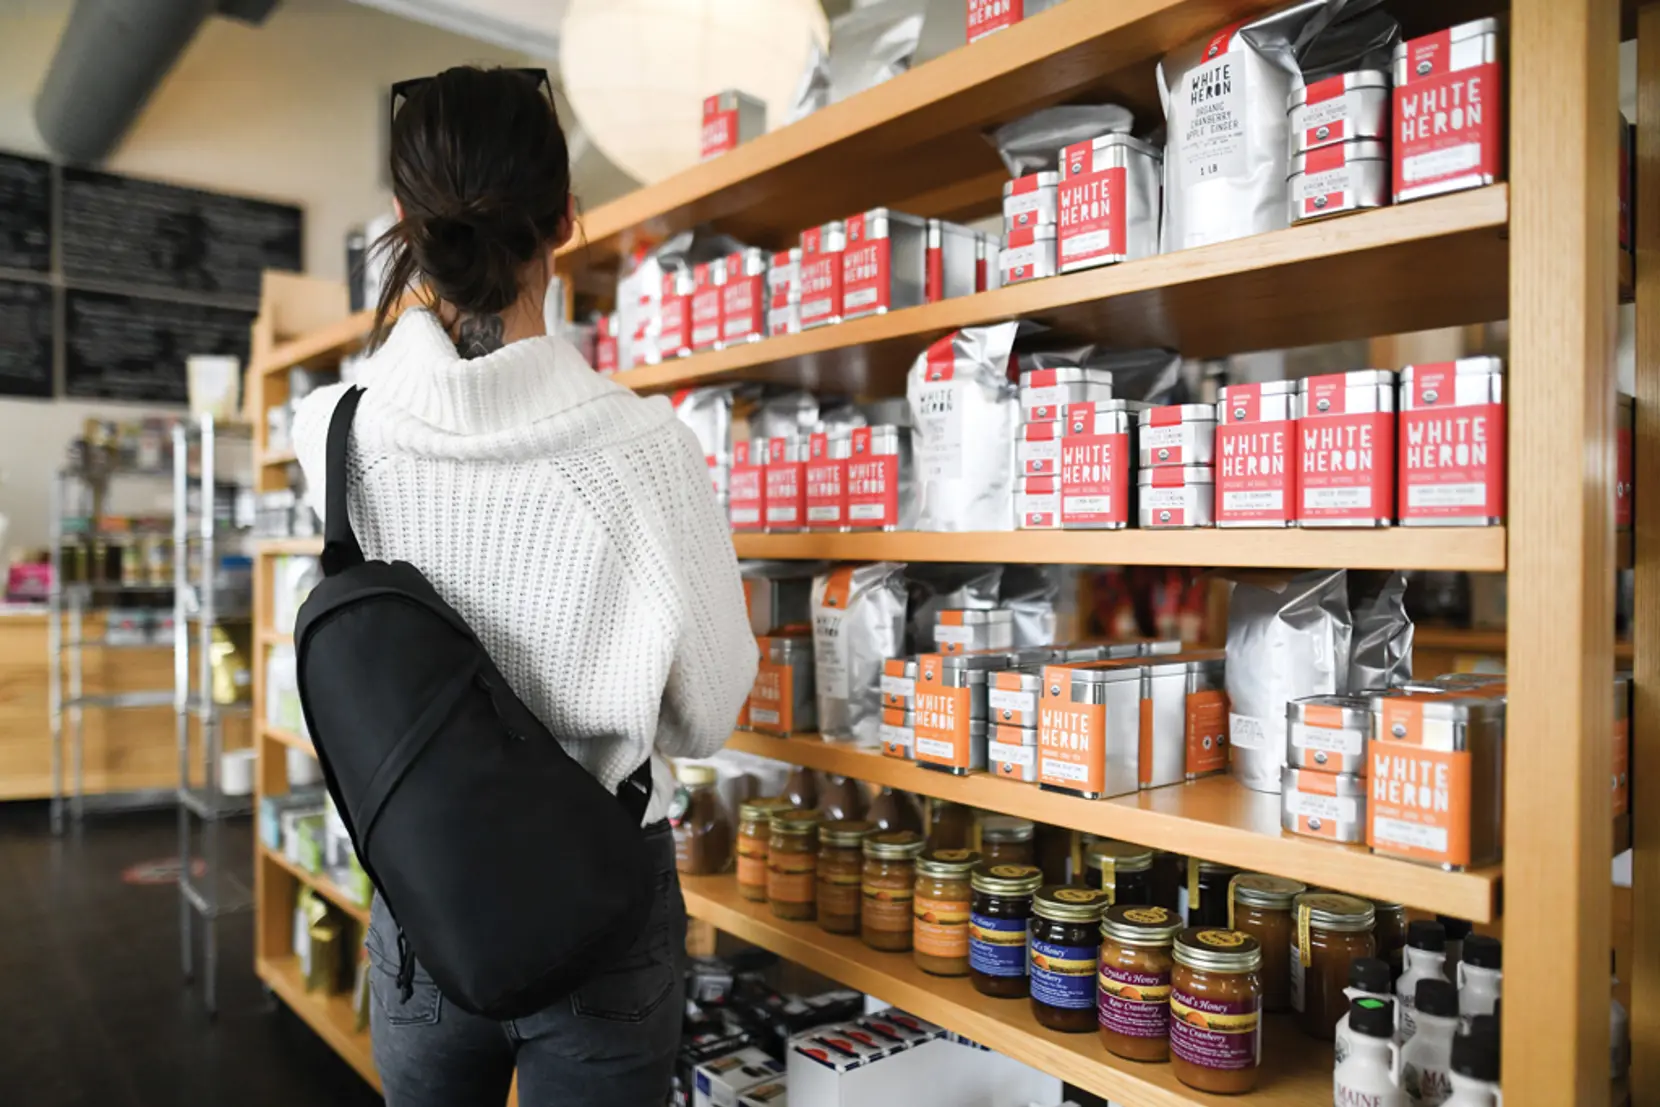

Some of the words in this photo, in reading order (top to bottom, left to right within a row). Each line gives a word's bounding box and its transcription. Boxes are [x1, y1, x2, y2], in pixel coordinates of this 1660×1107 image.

[1192, 64, 1231, 91] WHITE
[1190, 81, 1232, 106] HERON
[1402, 77, 1482, 118] WHITE
[1401, 103, 1482, 142] HERON
[1061, 179, 1110, 209] WHITE
[1061, 200, 1111, 227] HERON
[1304, 424, 1373, 449] WHITE
[1407, 417, 1487, 444] WHITE
[1063, 444, 1111, 465] WHITE
[1223, 432, 1284, 455] WHITE
[1407, 443, 1487, 468] HERON
[849, 462, 885, 479] WHITE
[1063, 464, 1112, 484] HERON
[1222, 455, 1285, 477] HERON
[1304, 450, 1373, 473] HERON
[916, 693, 955, 714] WHITE
[916, 710, 955, 730] HERON
[1041, 708, 1089, 733] WHITE
[1041, 729, 1089, 752] HERON
[1374, 753, 1449, 788] WHITE
[1374, 779, 1449, 812] HERON
[1133, 975, 1159, 986] Honey
[1199, 1000, 1228, 1014] Honey
